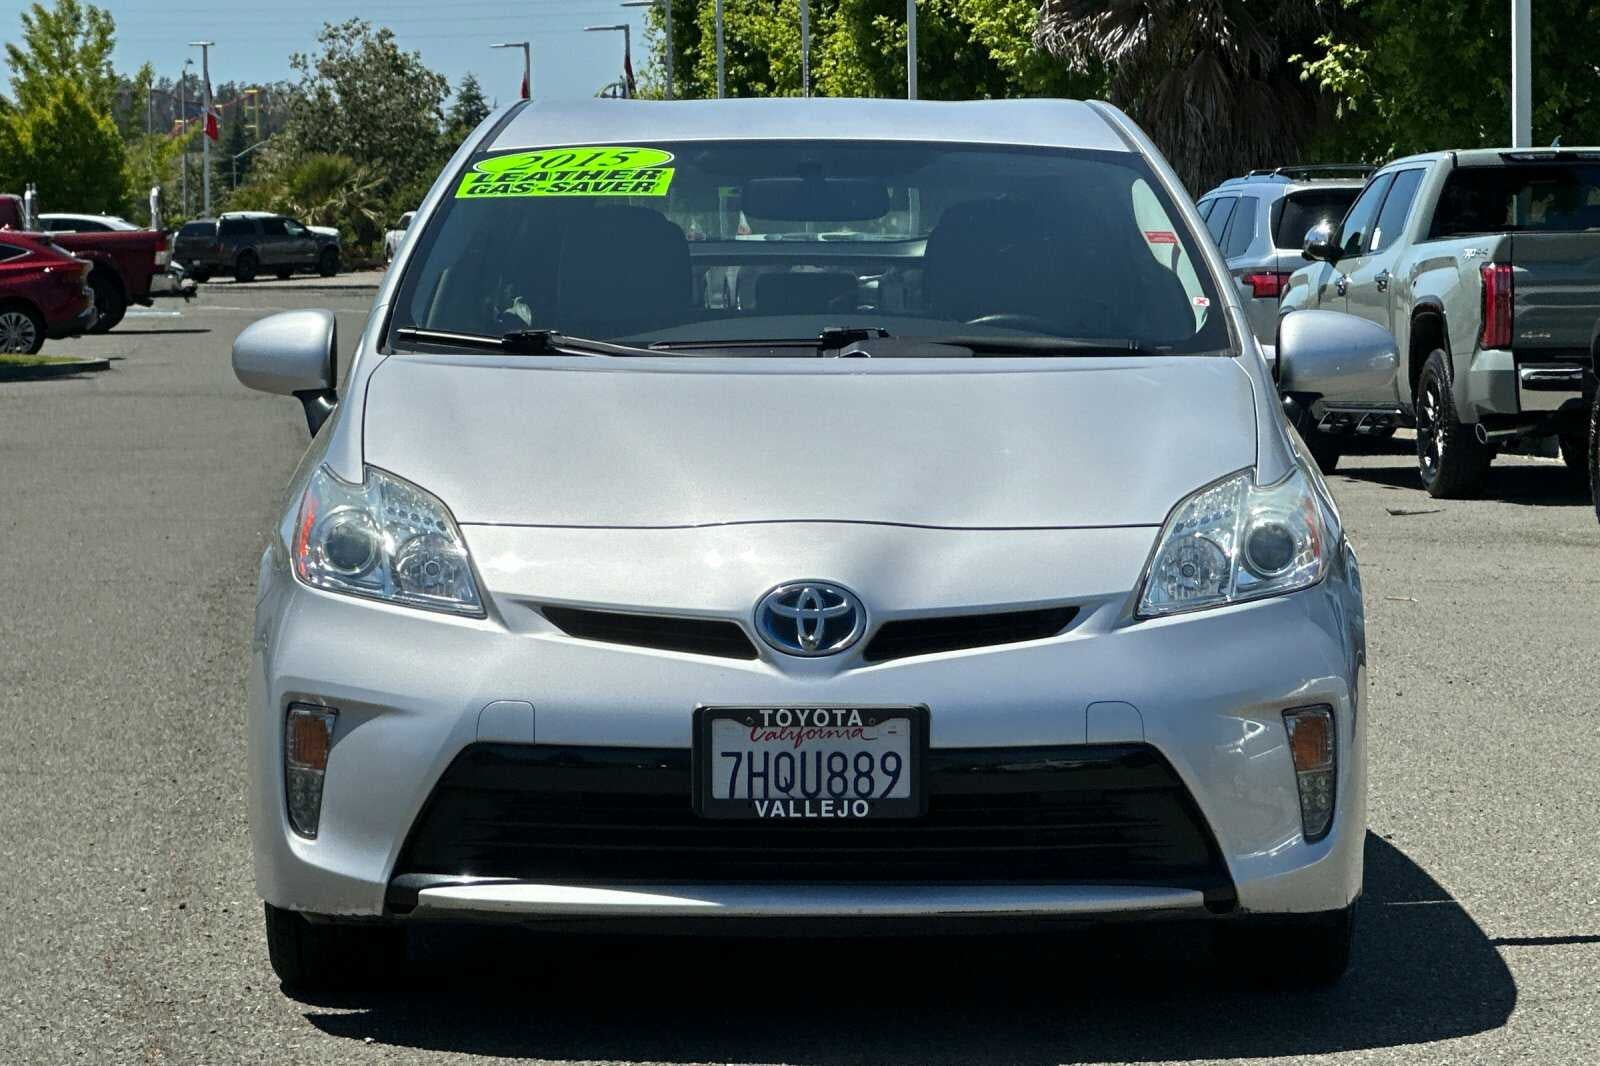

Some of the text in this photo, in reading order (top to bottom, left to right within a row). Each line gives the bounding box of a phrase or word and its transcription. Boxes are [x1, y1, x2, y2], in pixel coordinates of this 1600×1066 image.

[507, 150, 640, 171] 2015
[471, 168, 664, 183] LEATHER
[466, 180, 656, 195] GAS-SAVER
[759, 709, 863, 727] TOYOTA
[749, 725, 878, 749] California
[720, 751, 903, 800] 7HQU889
[754, 800, 869, 818] VALLEJO
